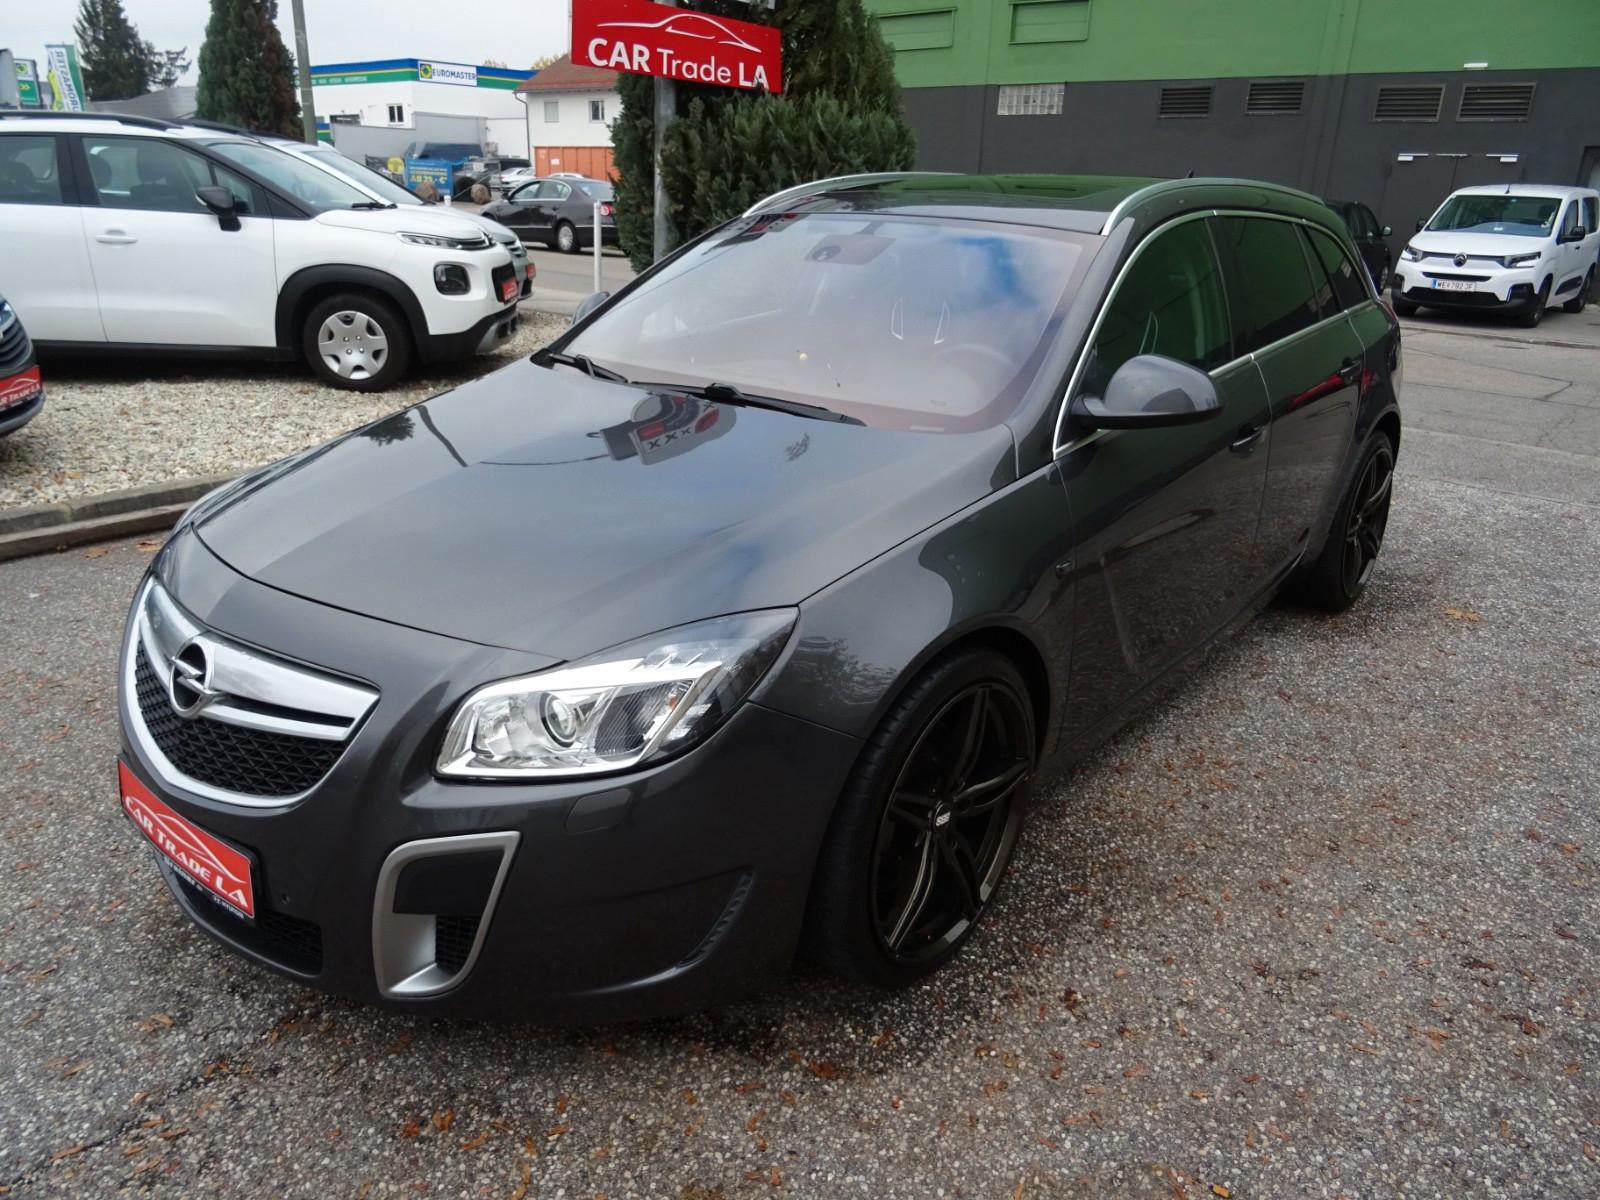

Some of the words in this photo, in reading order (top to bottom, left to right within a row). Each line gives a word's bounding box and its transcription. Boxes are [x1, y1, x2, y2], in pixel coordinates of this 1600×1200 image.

[432, 68, 476, 81] EUROMASTER
[588, 37, 651, 73] CAR
[656, 47, 732, 84] Trade
[738, 62, 770, 90] LA
[125, 796, 154, 836] CAR
[156, 827, 212, 883] TRADE
[215, 875, 249, 908] LA
